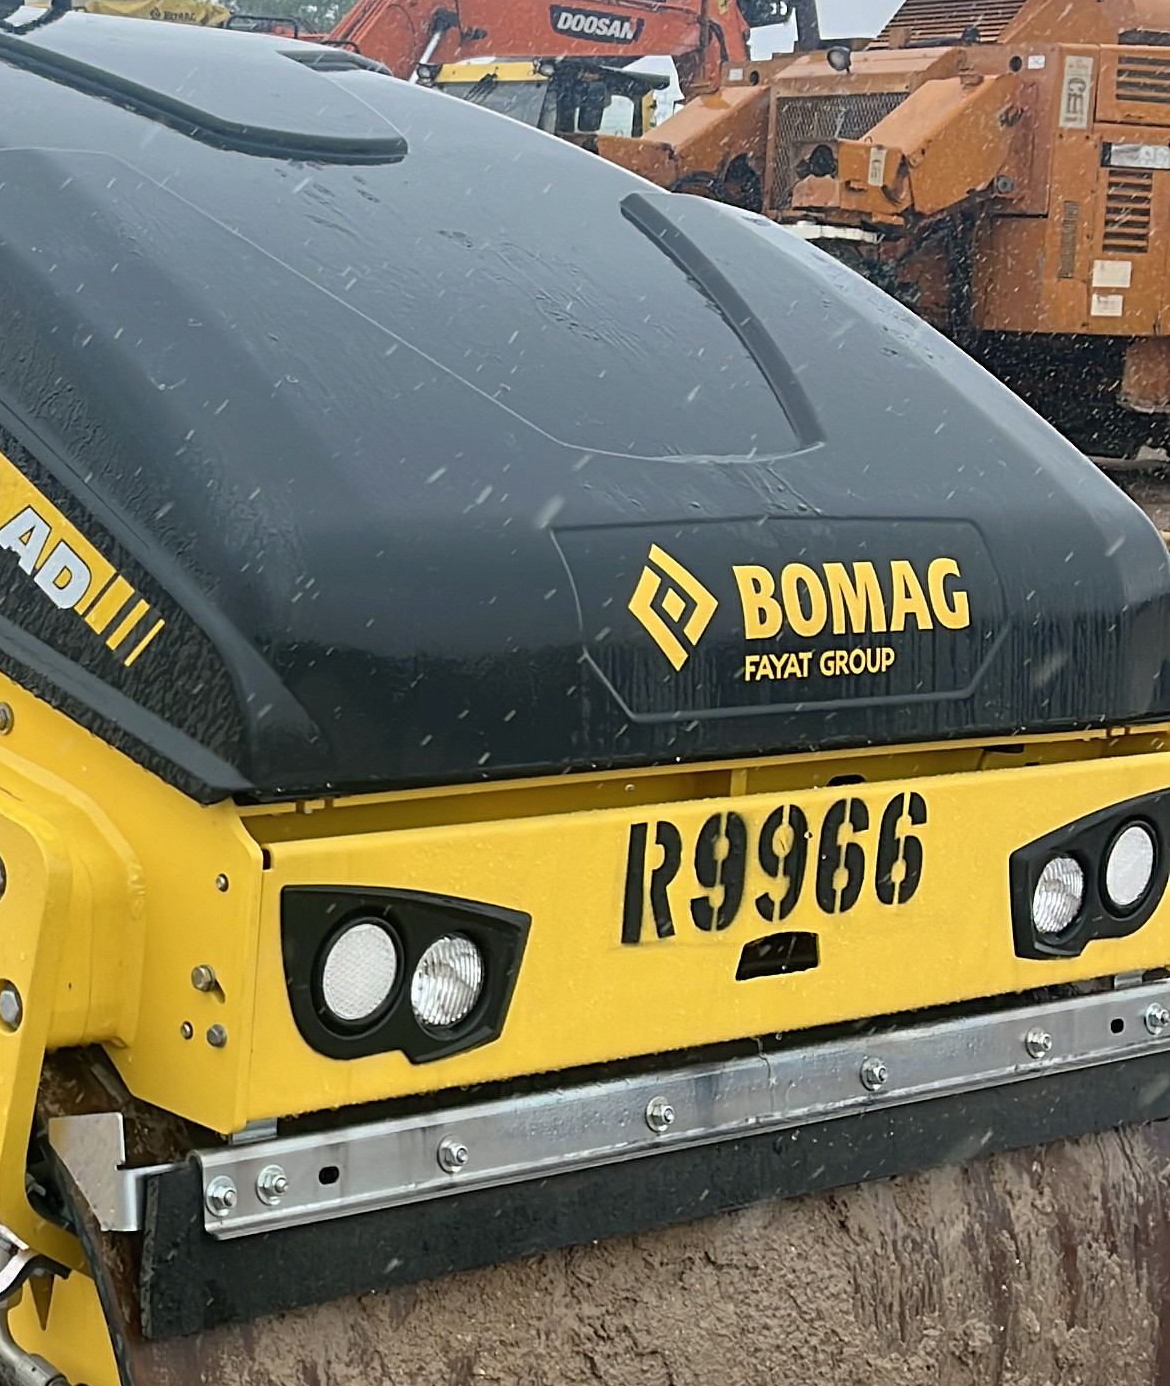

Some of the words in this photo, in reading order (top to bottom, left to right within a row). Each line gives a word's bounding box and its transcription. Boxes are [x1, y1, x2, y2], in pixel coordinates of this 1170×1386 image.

[557, 11, 634, 40] DOOSAN
[732, 557, 970, 641] BOMAG
[744, 651, 814, 682] FAYAT
[819, 647, 896, 677] GROUP
[621, 791, 928, 945] R9966
